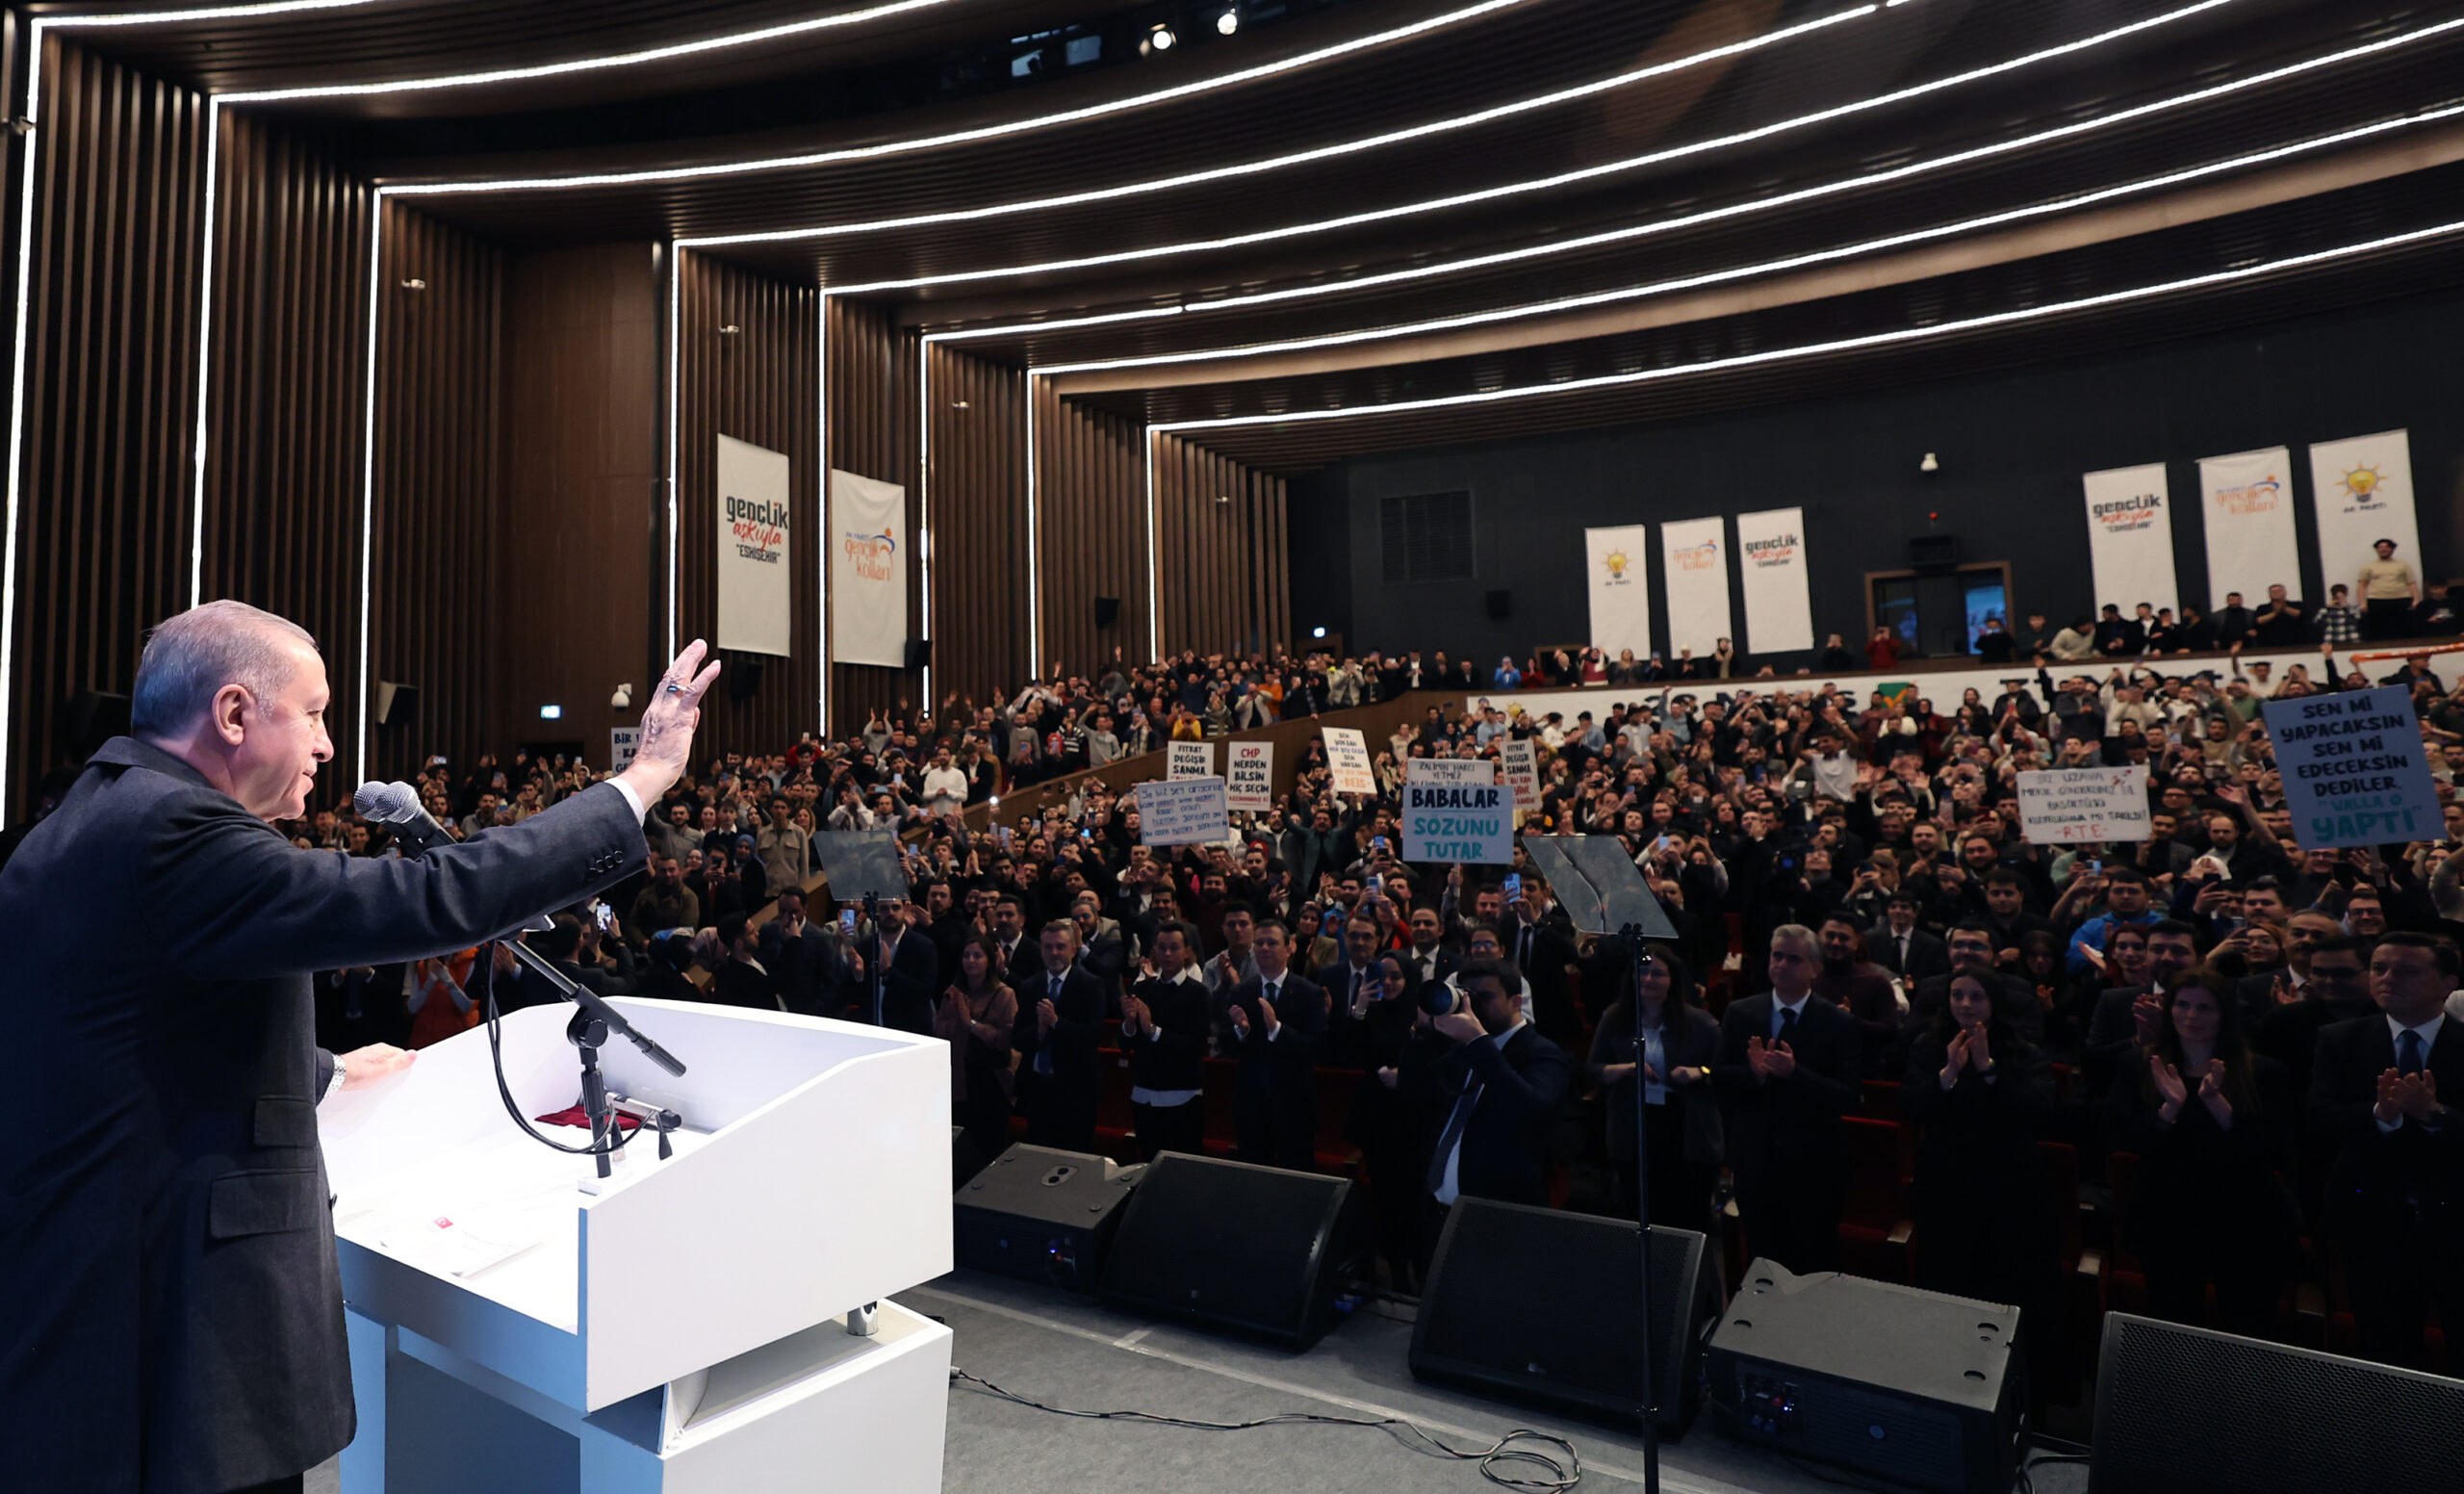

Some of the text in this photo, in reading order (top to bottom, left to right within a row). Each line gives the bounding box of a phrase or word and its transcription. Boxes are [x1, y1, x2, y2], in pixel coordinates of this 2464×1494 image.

[727, 496, 788, 529] gençlik
[732, 518, 782, 552] aşkıyla
[2302, 696, 2374, 719] SEN Mİ
[614, 733, 631, 744] BİR
[2280, 714, 2405, 743] YAPACAKSIN
[1241, 748, 1261, 758] CHP
[2313, 735, 2383, 758] SEN Mİ
[1234, 760, 1267, 769] NERDEN
[1235, 771, 1265, 781] BİLSİN
[2297, 754, 2408, 779] EDECEKSİN
[1230, 783, 1270, 793] HİÇ SEÇİM
[1411, 788, 1500, 809] BABALAR
[1413, 813, 1500, 837] SÖZÜNÜ
